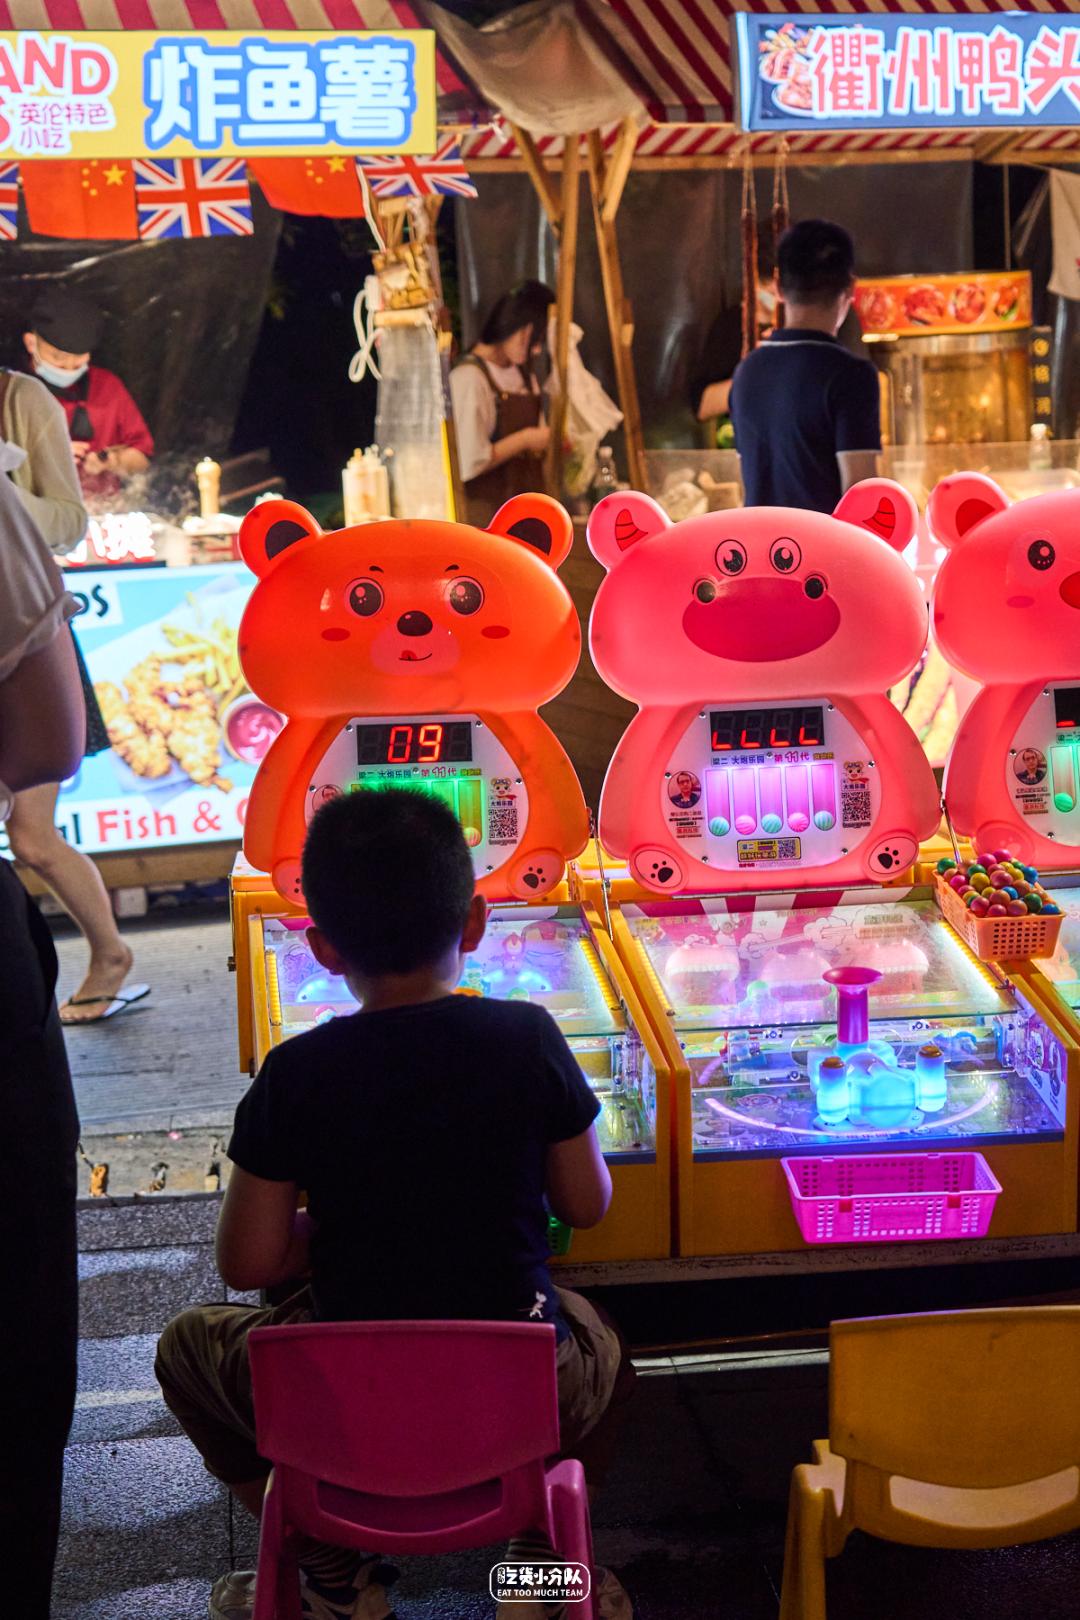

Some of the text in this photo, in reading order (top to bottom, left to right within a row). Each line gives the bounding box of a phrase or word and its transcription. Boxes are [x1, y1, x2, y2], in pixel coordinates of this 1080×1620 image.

[813, 30, 1080, 113] 衢州鸭头
[149, 42, 412, 144] 炸鱼薯
[19, 102, 110, 126] 英伦特色
[20, 126, 66, 149] 小吃
[387, 724, 443, 763] 09
[97, 805, 177, 843] Fish
[192, 800, 222, 833] &
